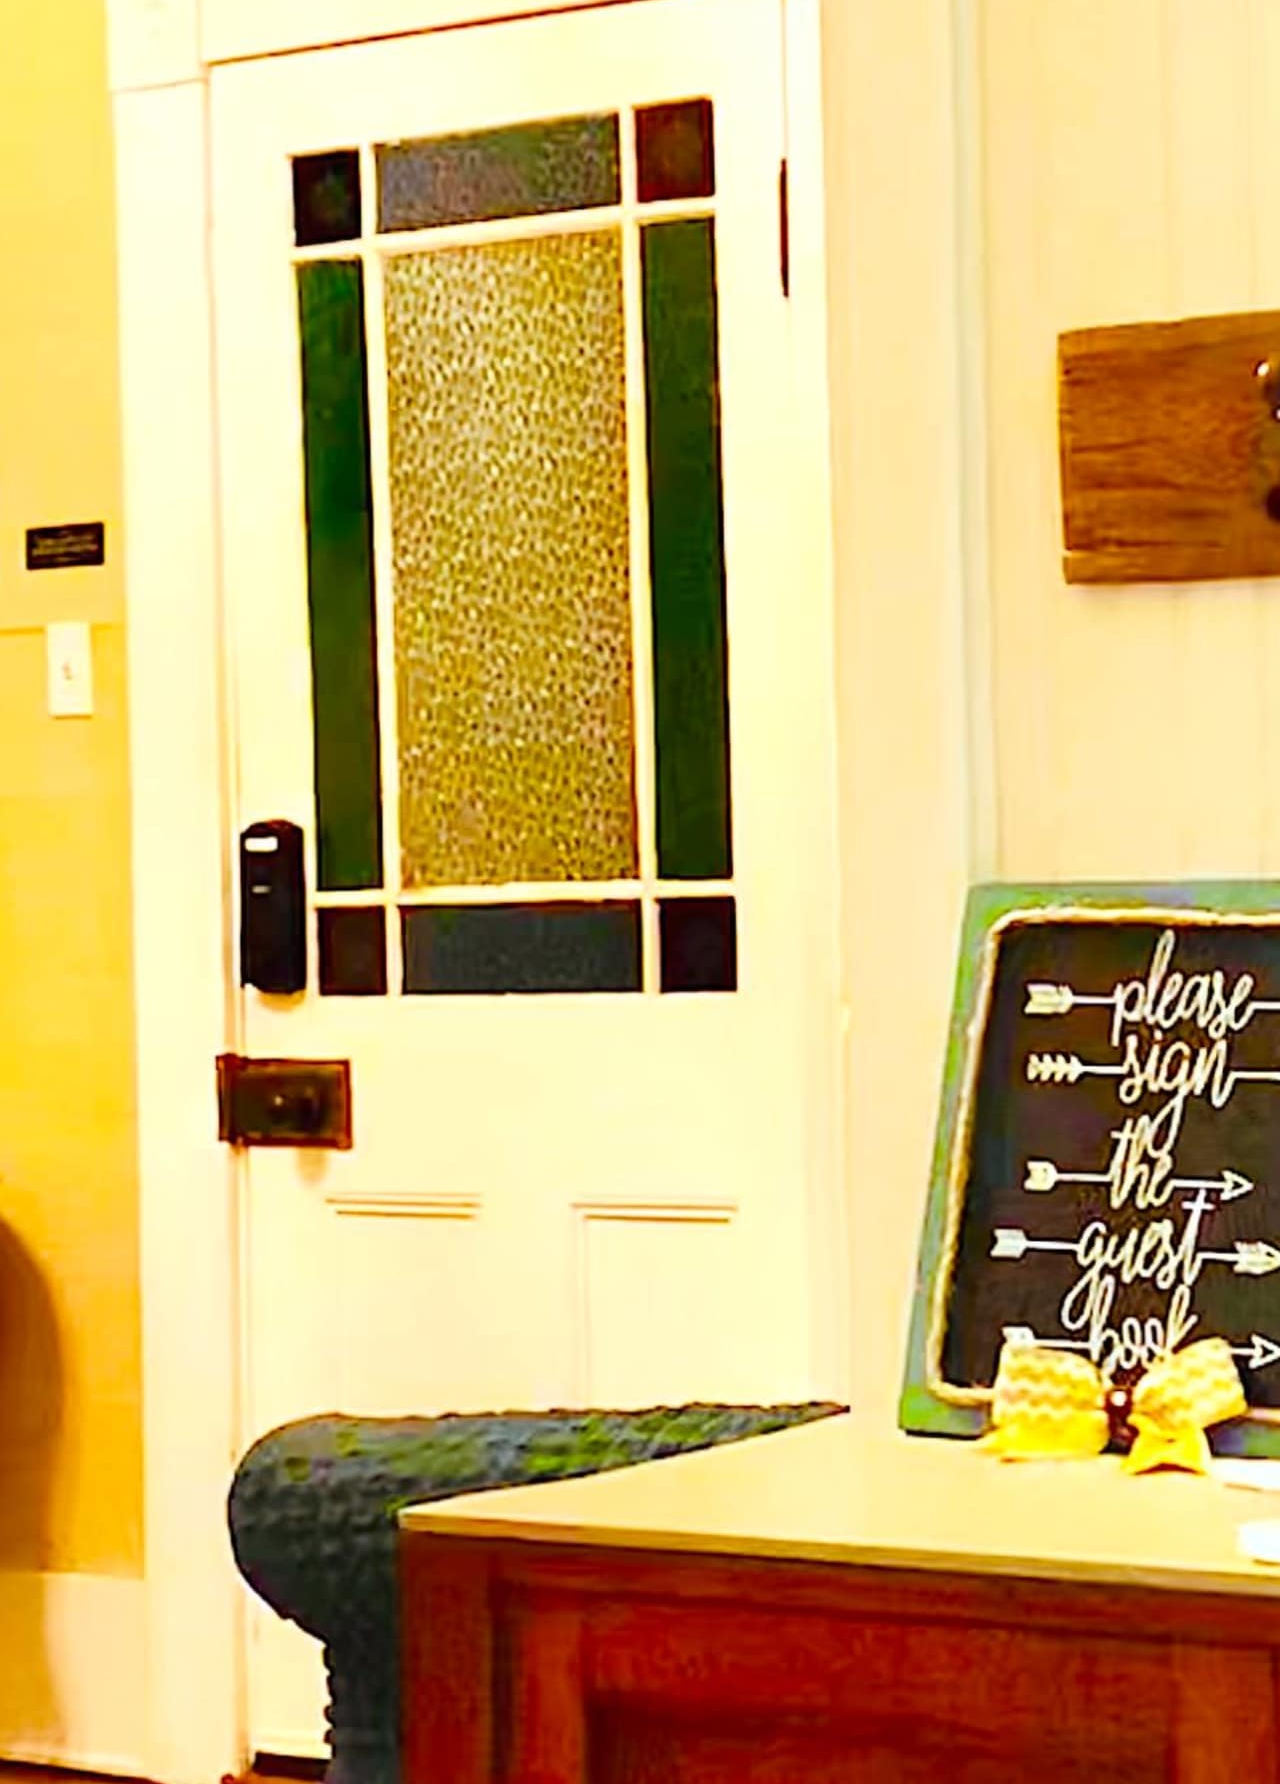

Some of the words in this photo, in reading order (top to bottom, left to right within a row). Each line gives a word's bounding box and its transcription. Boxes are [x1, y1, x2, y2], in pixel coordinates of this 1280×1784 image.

[1110, 928, 1256, 1046] please
[1118, 1029, 1234, 1154] sign
[1109, 1115, 1176, 1209] the
[1060, 1188, 1217, 1331] guest
